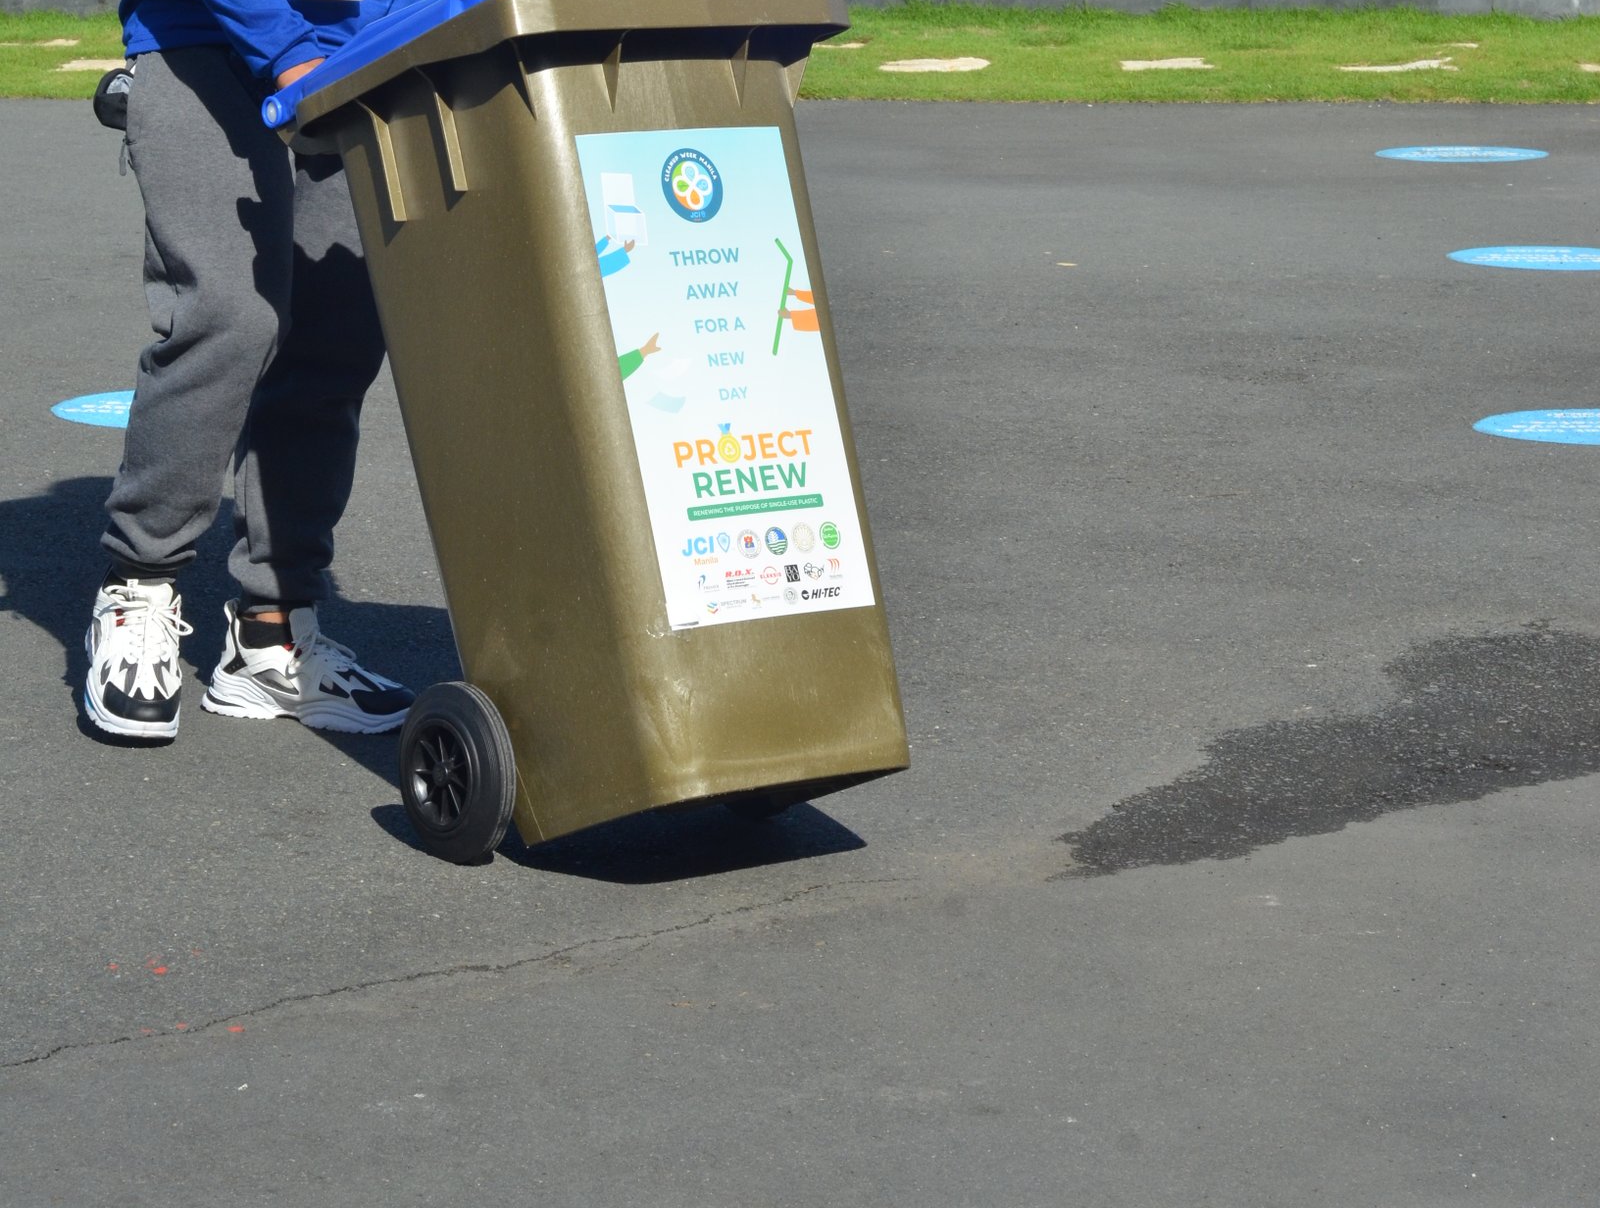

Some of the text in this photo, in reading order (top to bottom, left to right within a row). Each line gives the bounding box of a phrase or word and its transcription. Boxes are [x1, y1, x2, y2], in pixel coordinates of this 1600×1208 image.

[664, 152, 718, 183] CLEANUP WEEK MANILA
[669, 247, 739, 267] THROW
[686, 281, 739, 300] AWAY
[694, 316, 746, 334] FOR A
[707, 351, 745, 368] NEW
[718, 386, 748, 401] DAY
[673, 429, 812, 469] PROJECT
[692, 461, 807, 499] RENEW
[693, 507, 724, 517] RENEWING
[735, 503, 760, 512] PURPOSE
[769, 499, 798, 508] SINGLE-USE
[798, 497, 818, 505] PLASTIC
[682, 535, 715, 557] JCI
[694, 556, 719, 566] Manila
